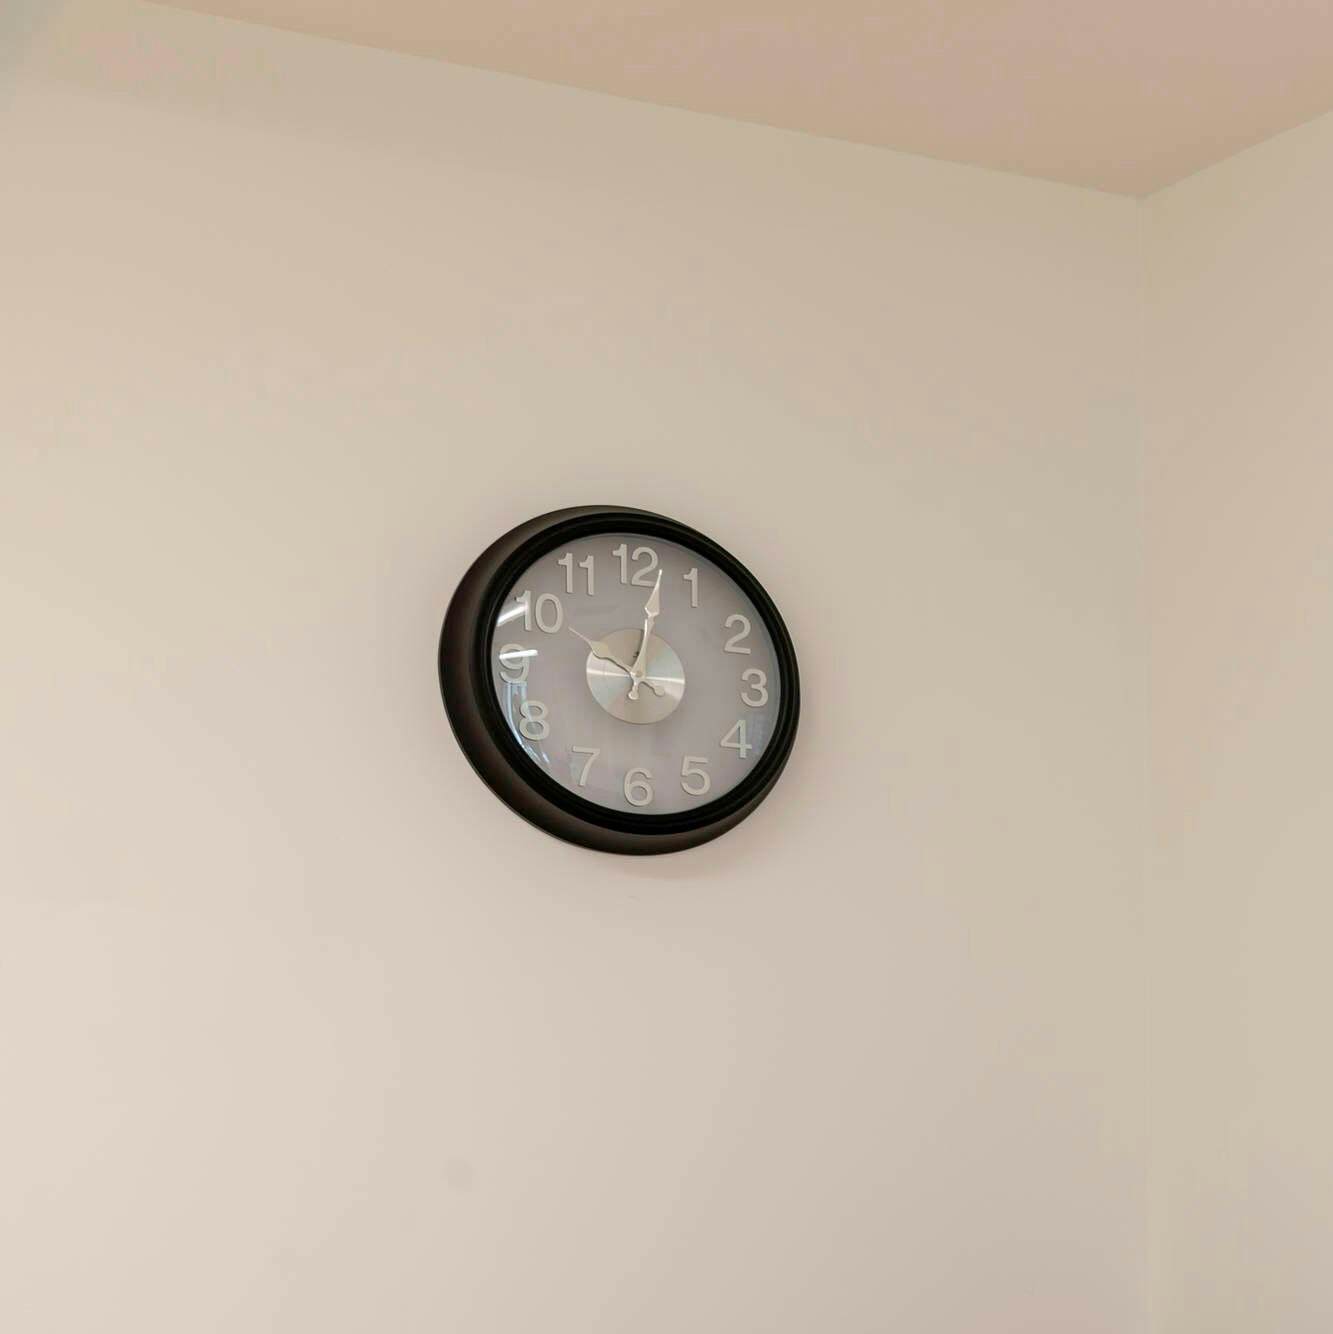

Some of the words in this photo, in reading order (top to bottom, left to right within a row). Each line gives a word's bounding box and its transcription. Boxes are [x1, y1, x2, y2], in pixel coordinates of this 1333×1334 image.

[558, 552, 595, 595] 11
[613, 543, 660, 588] 12
[683, 567, 698, 608] 1
[516, 589, 564, 633] 10
[724, 613, 751, 655] 2
[500, 643, 530, 683] 9
[741, 668, 768, 708] 3
[519, 701, 550, 741] 8
[720, 719, 752, 759] 4
[572, 746, 601, 786] 7
[681, 755, 711, 796] 5
[623, 767, 654, 806] 6
